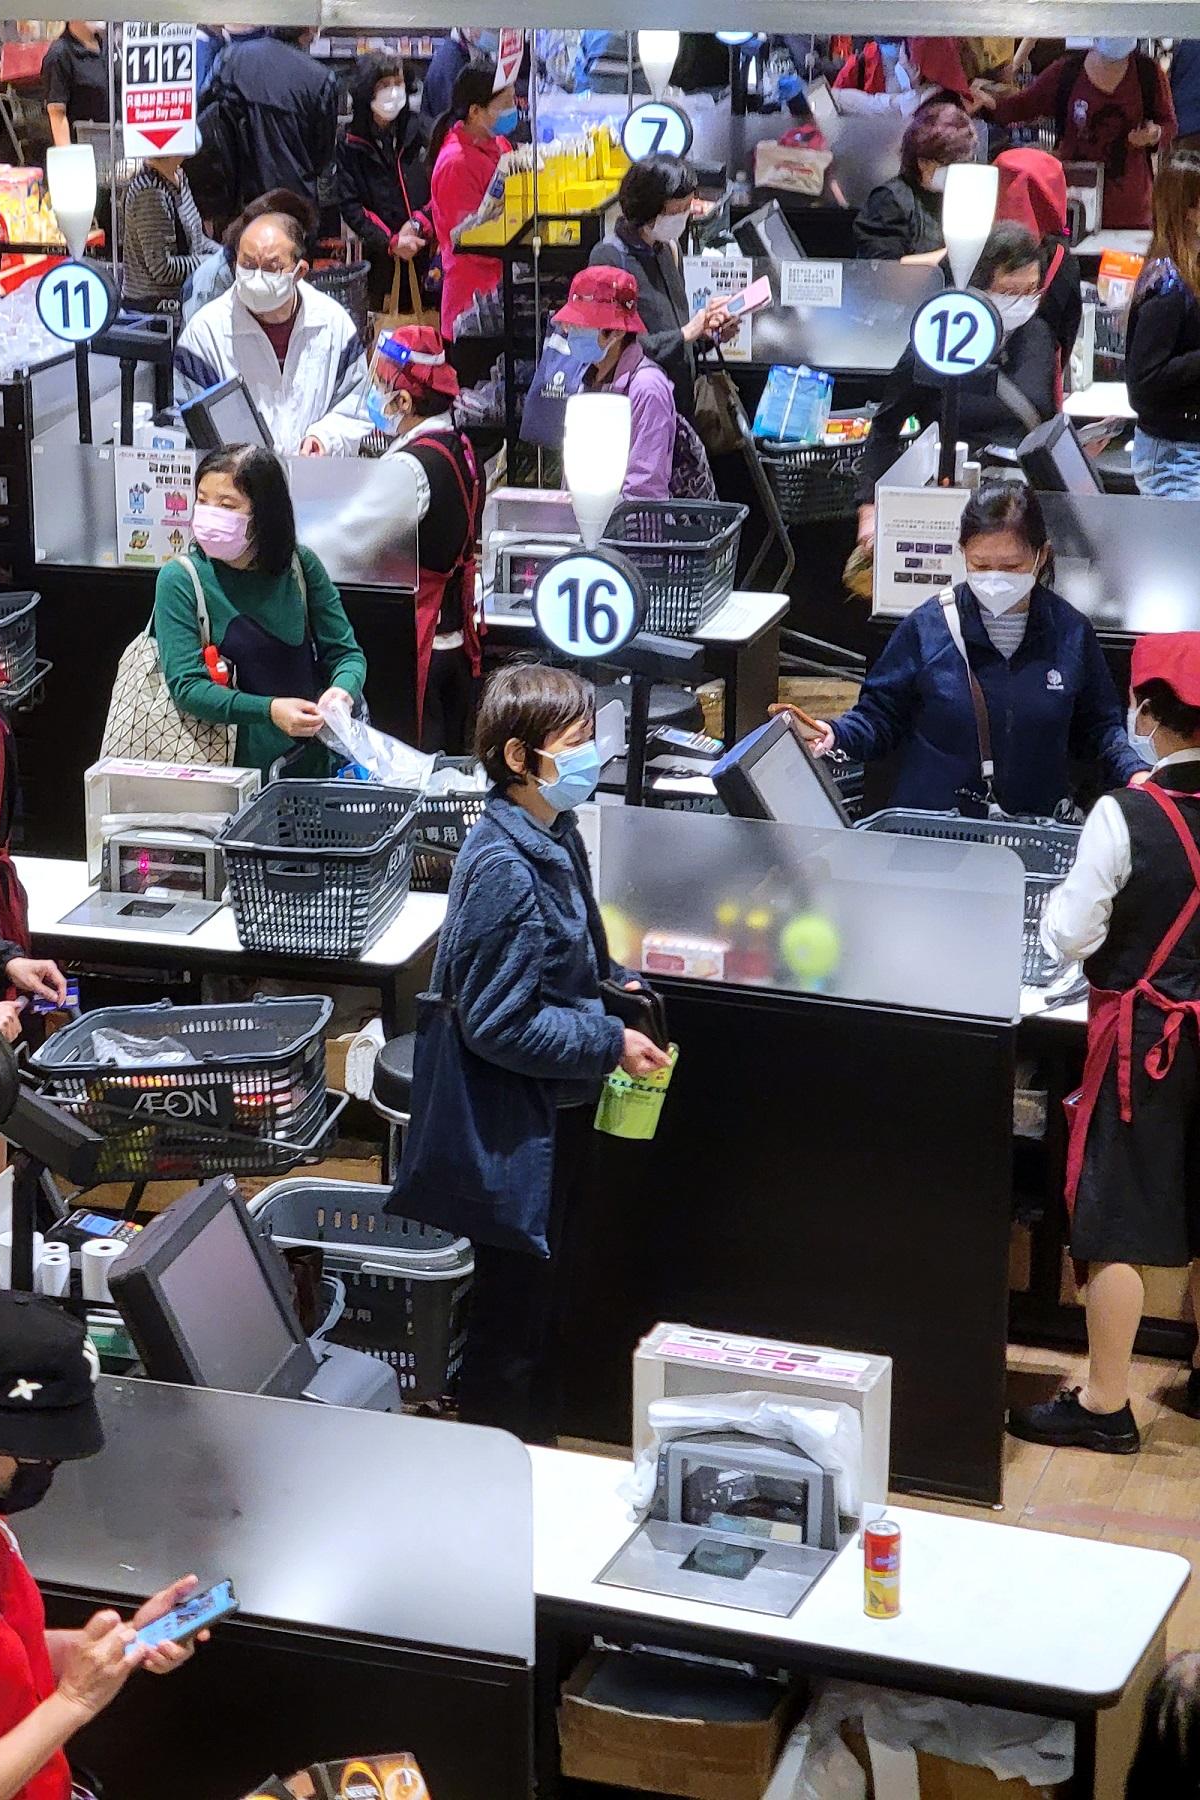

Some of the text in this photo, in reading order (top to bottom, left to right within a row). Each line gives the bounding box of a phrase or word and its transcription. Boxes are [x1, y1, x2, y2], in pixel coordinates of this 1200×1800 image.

[128, 44, 192, 83] 11 12
[641, 117, 668, 155] 7
[53, 280, 91, 328] 11
[930, 309, 979, 365] 12
[557, 577, 619, 645] 16
